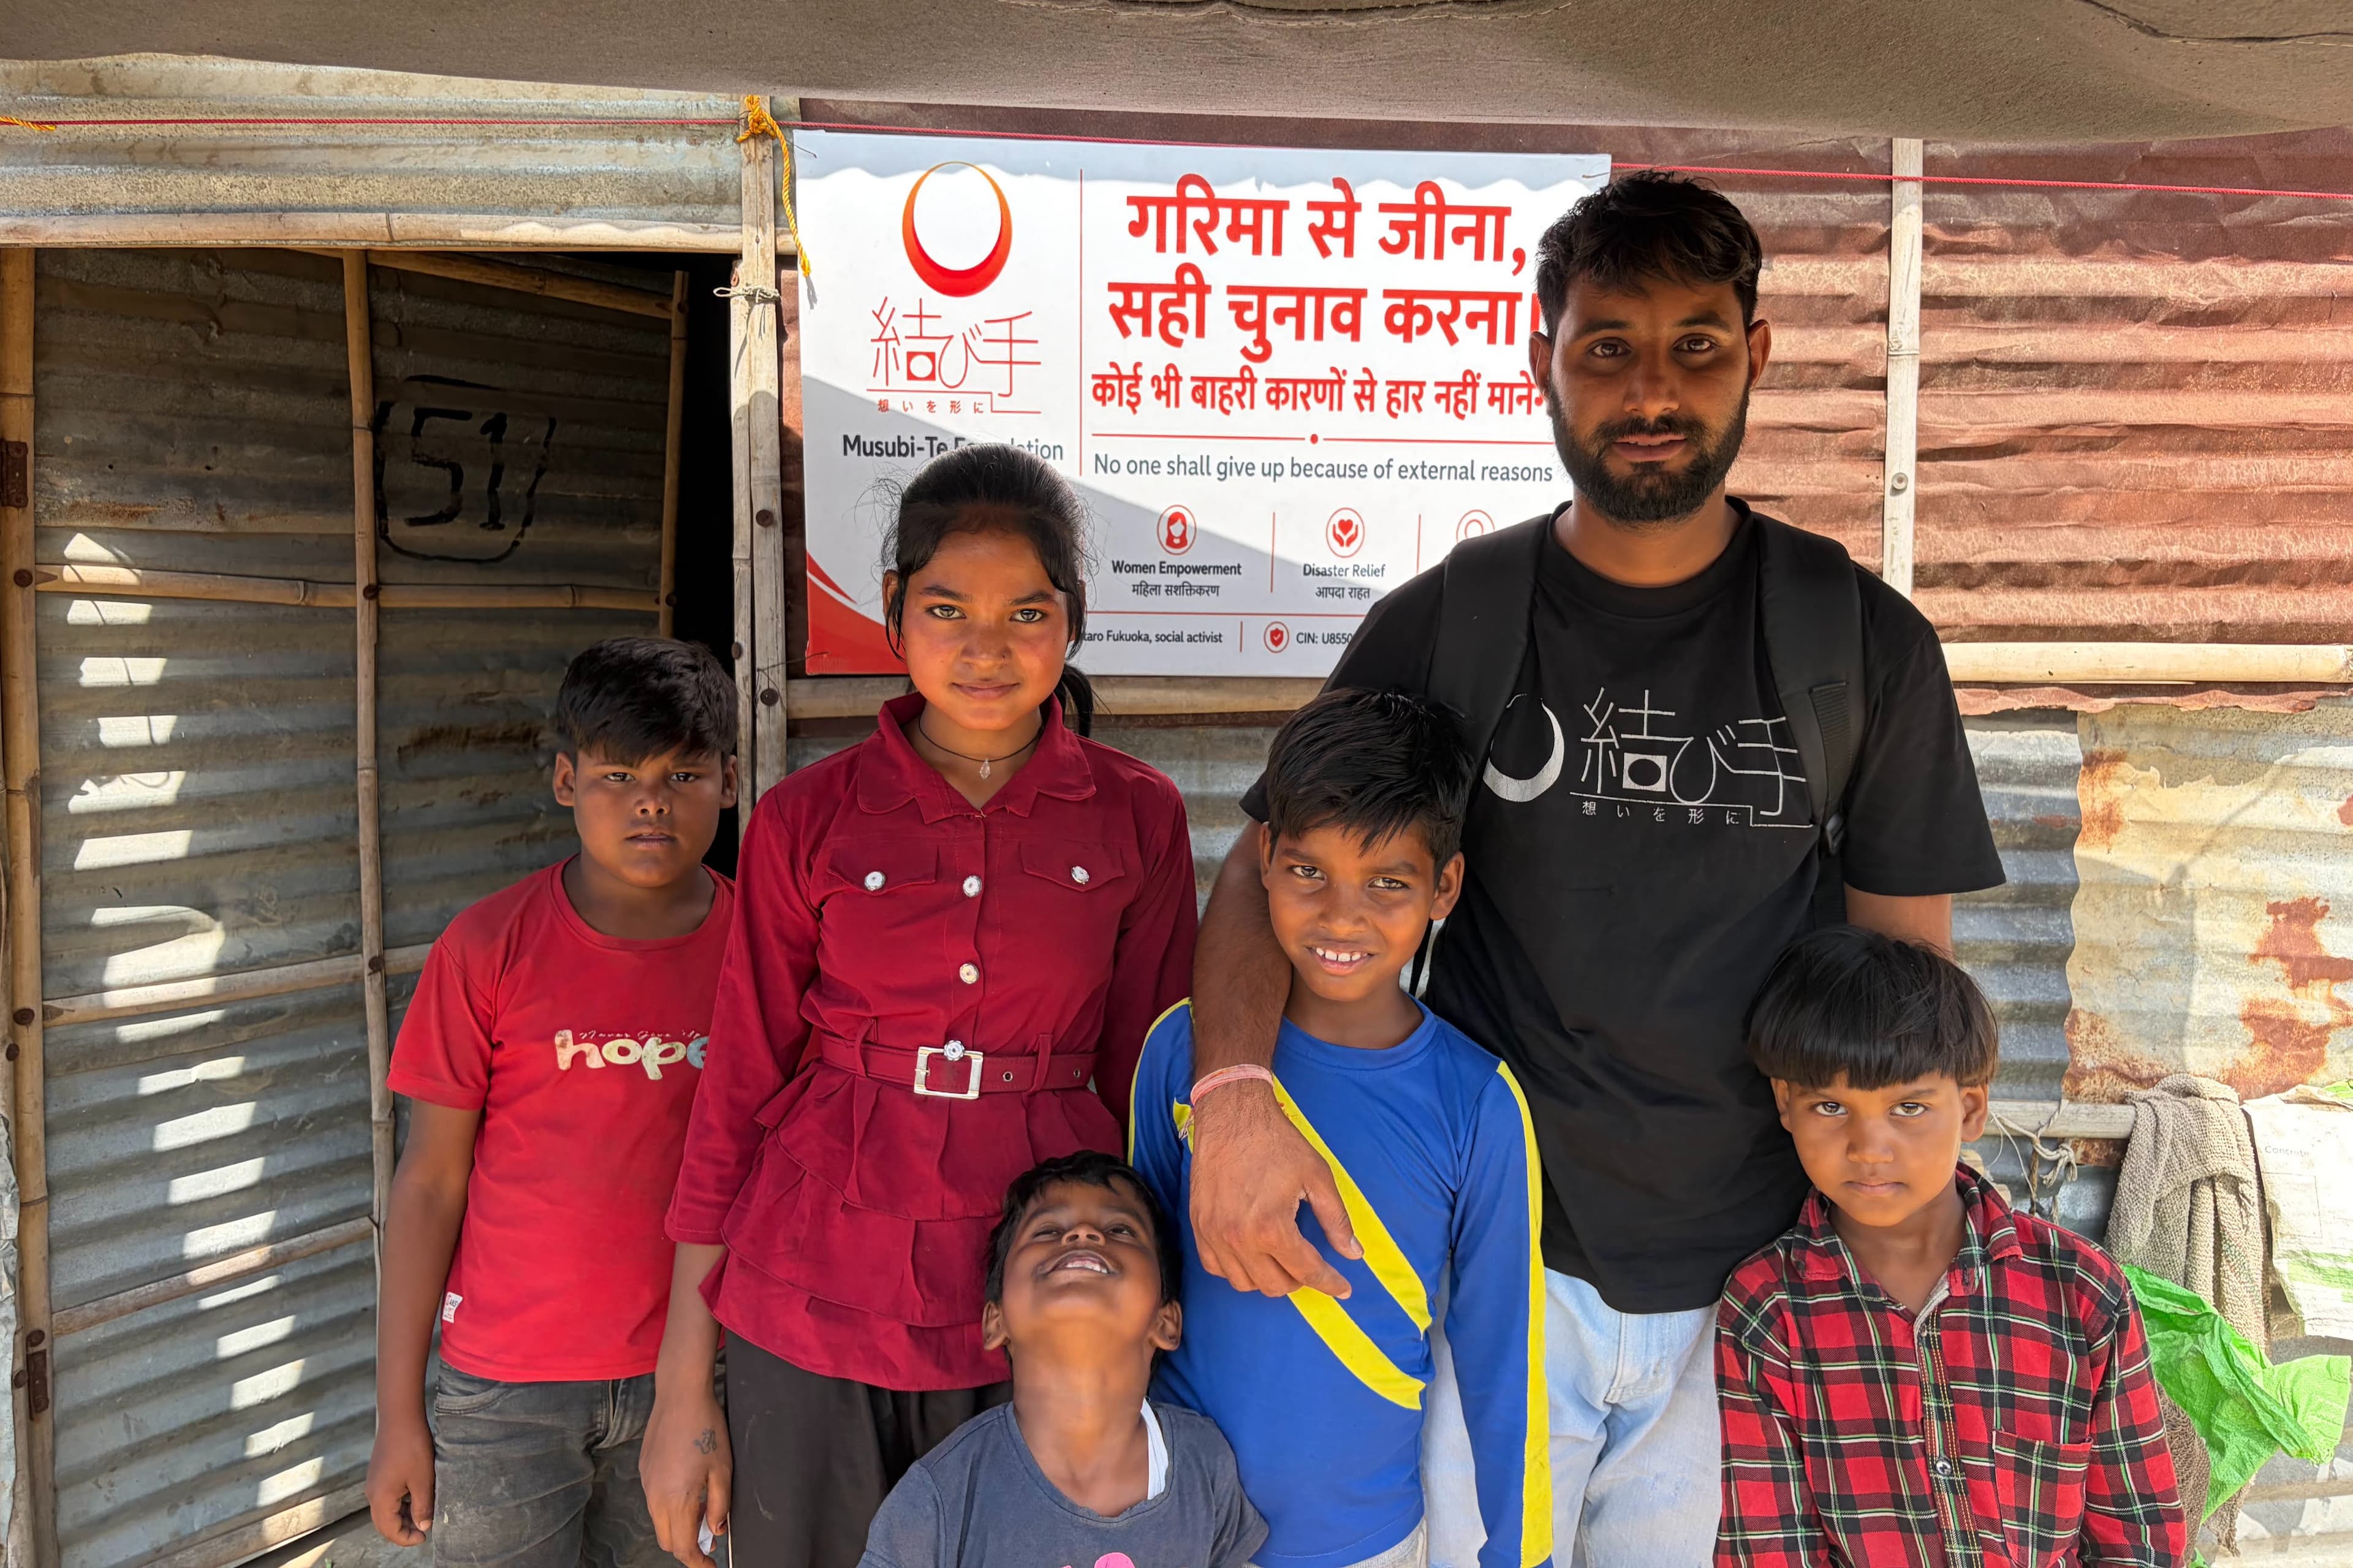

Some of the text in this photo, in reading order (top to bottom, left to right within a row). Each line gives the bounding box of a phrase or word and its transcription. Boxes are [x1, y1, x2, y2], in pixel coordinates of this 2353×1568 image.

[1127, 174, 1526, 276] गरिमा से जीना,
[1108, 262, 1211, 348] सही
[1227, 285, 1367, 363] चुनाव
[1091, 361, 1544, 420] कोई भी बाहरी कारणों से हार नहीं माने
[877, 398, 985, 414] 想いを形に
[843, 434, 948, 458] Musubi-Te
[404, 407, 508, 532] 51
[1094, 453, 1553, 483] No one shall give up because of external reasons
[1112, 560, 1242, 578] Women Empowerment
[1303, 563, 1386, 578] Disaster Relief
[1132, 580, 1220, 597] महिला सशक्तिकरण
[1316, 586, 1371, 600] आपदा राहत
[1083, 630, 1223, 644] taro Fukuoka, social activist
[1296, 632, 1353, 645] CIN: U8550
[1582, 799, 1739, 825] 想いを形に
[555, 1029, 709, 1080] hope
